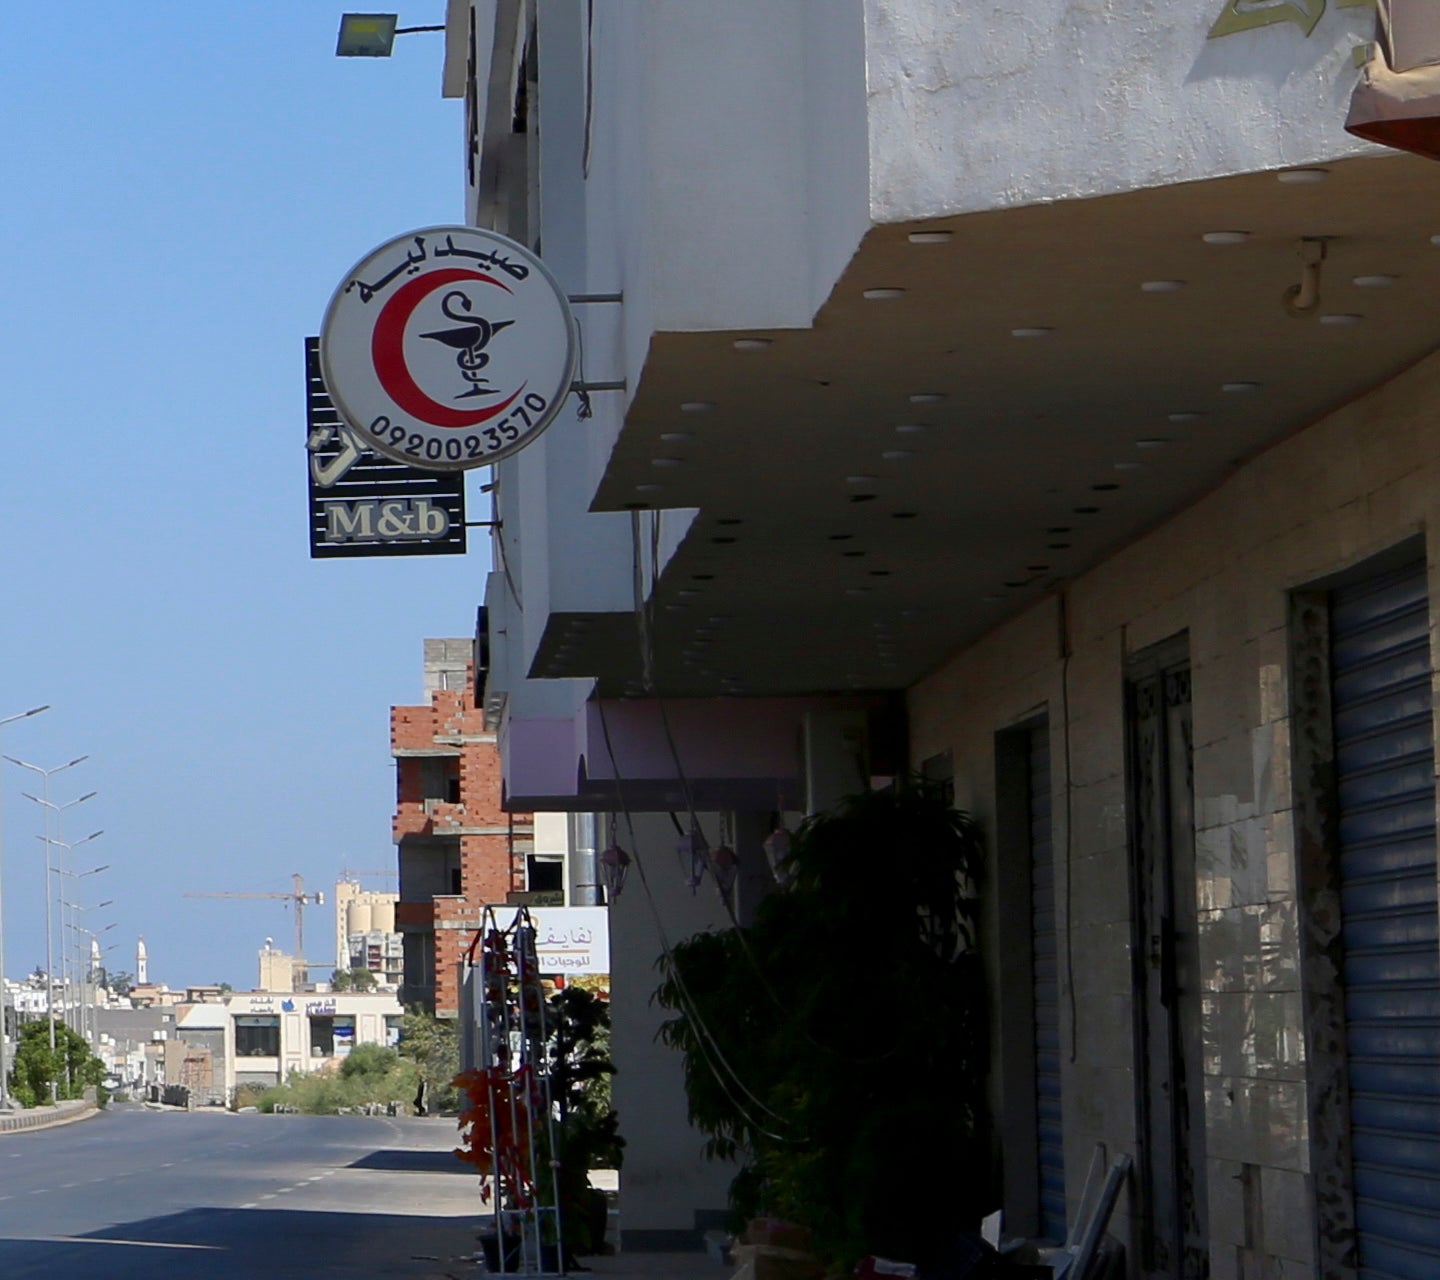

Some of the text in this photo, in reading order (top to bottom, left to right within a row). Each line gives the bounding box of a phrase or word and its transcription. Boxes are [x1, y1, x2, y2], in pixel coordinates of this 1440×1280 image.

[344, 234, 530, 304] صيدلية
[370, 392, 547, 460] 0920023570
[328, 500, 446, 539] M&b
